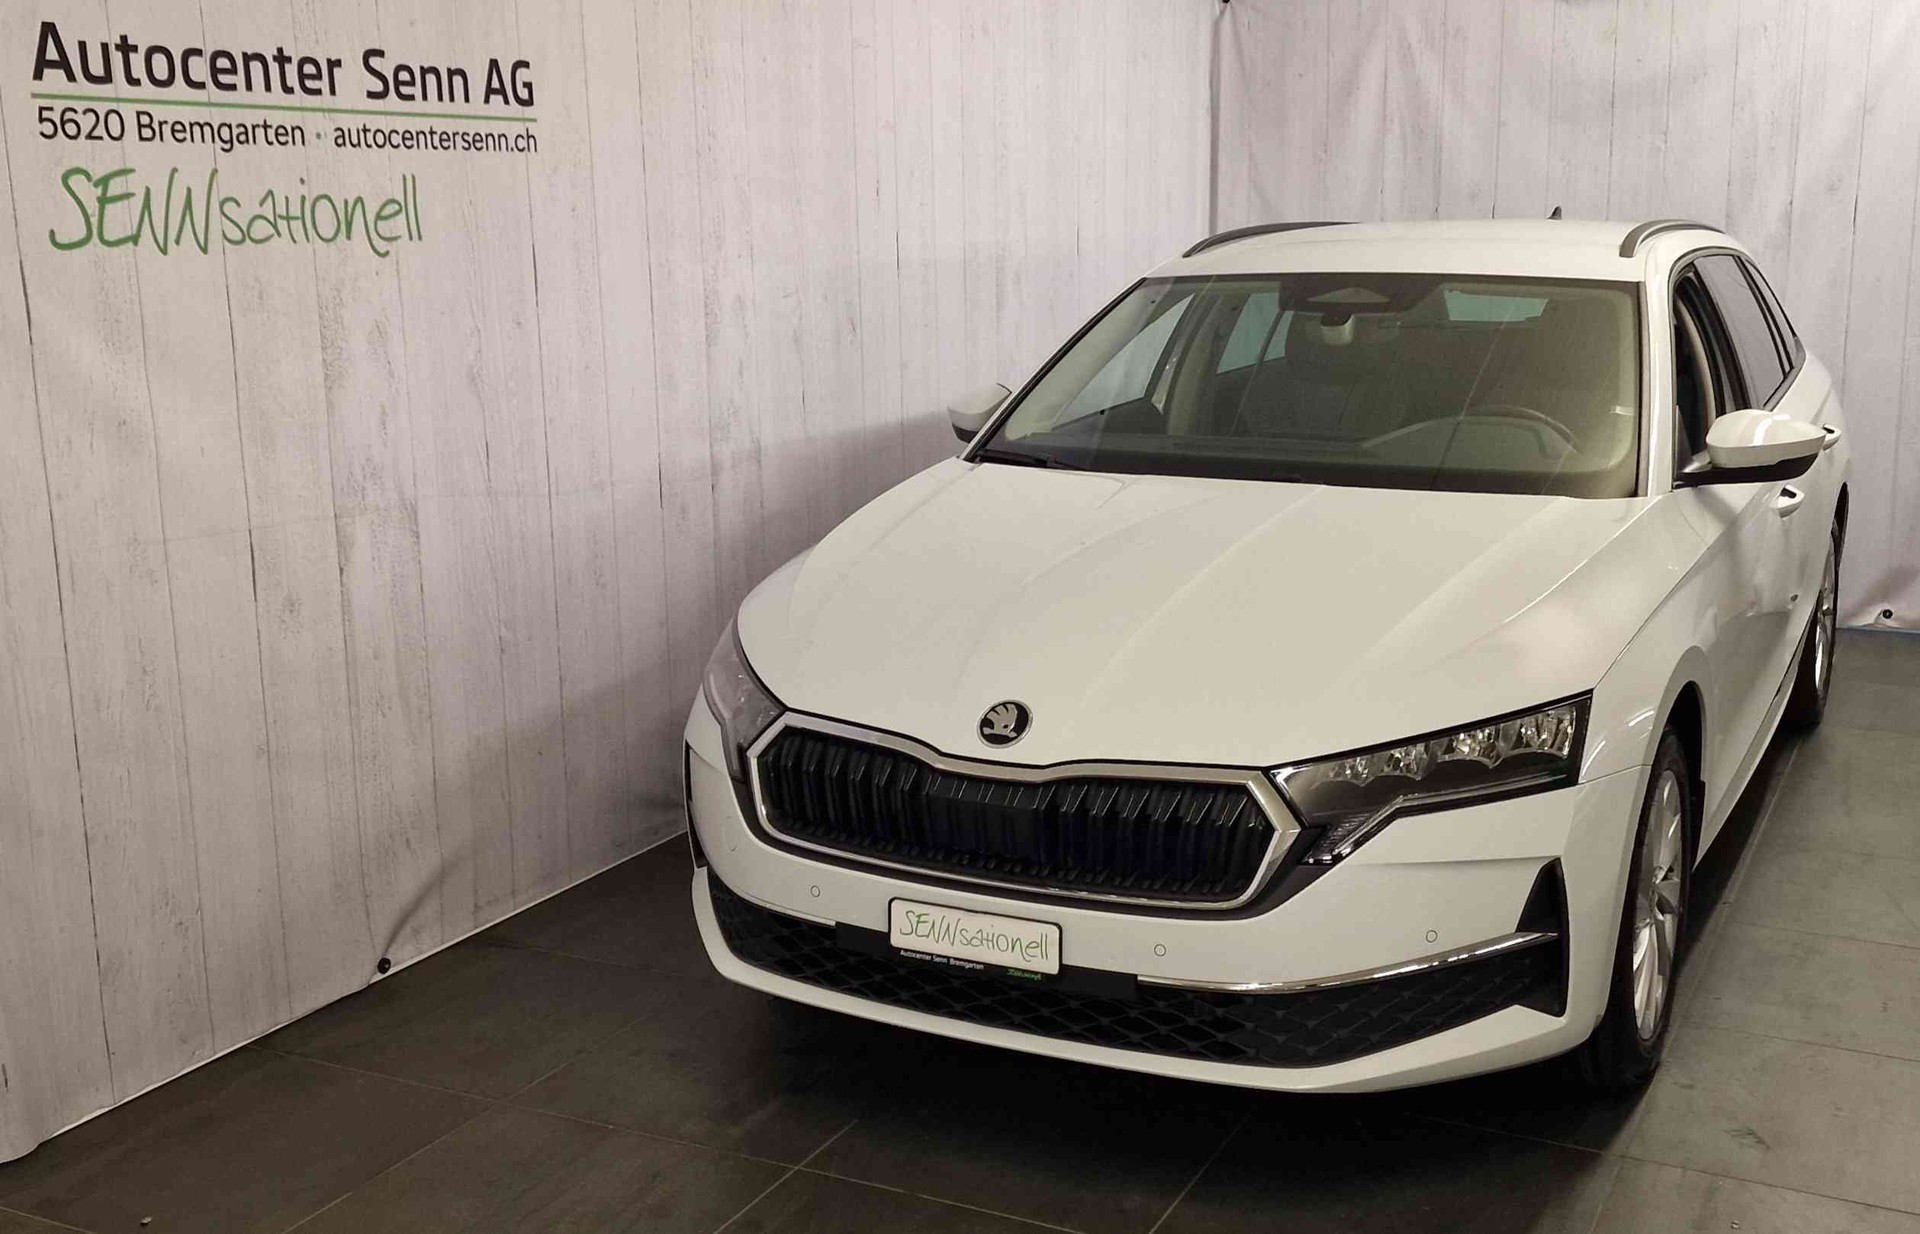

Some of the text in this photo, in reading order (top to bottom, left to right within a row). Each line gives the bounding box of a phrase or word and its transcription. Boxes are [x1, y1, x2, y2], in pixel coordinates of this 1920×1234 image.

[33, 21, 535, 108] Autocenter Senn AG
[37, 105, 538, 153] 5620 Bremgarten autocentersenn.ch
[48, 166, 423, 257] SENNsationell
[900, 910, 1049, 962] SENNsationell
[900, 949, 984, 970] Autocenter Senn Bremgarten
